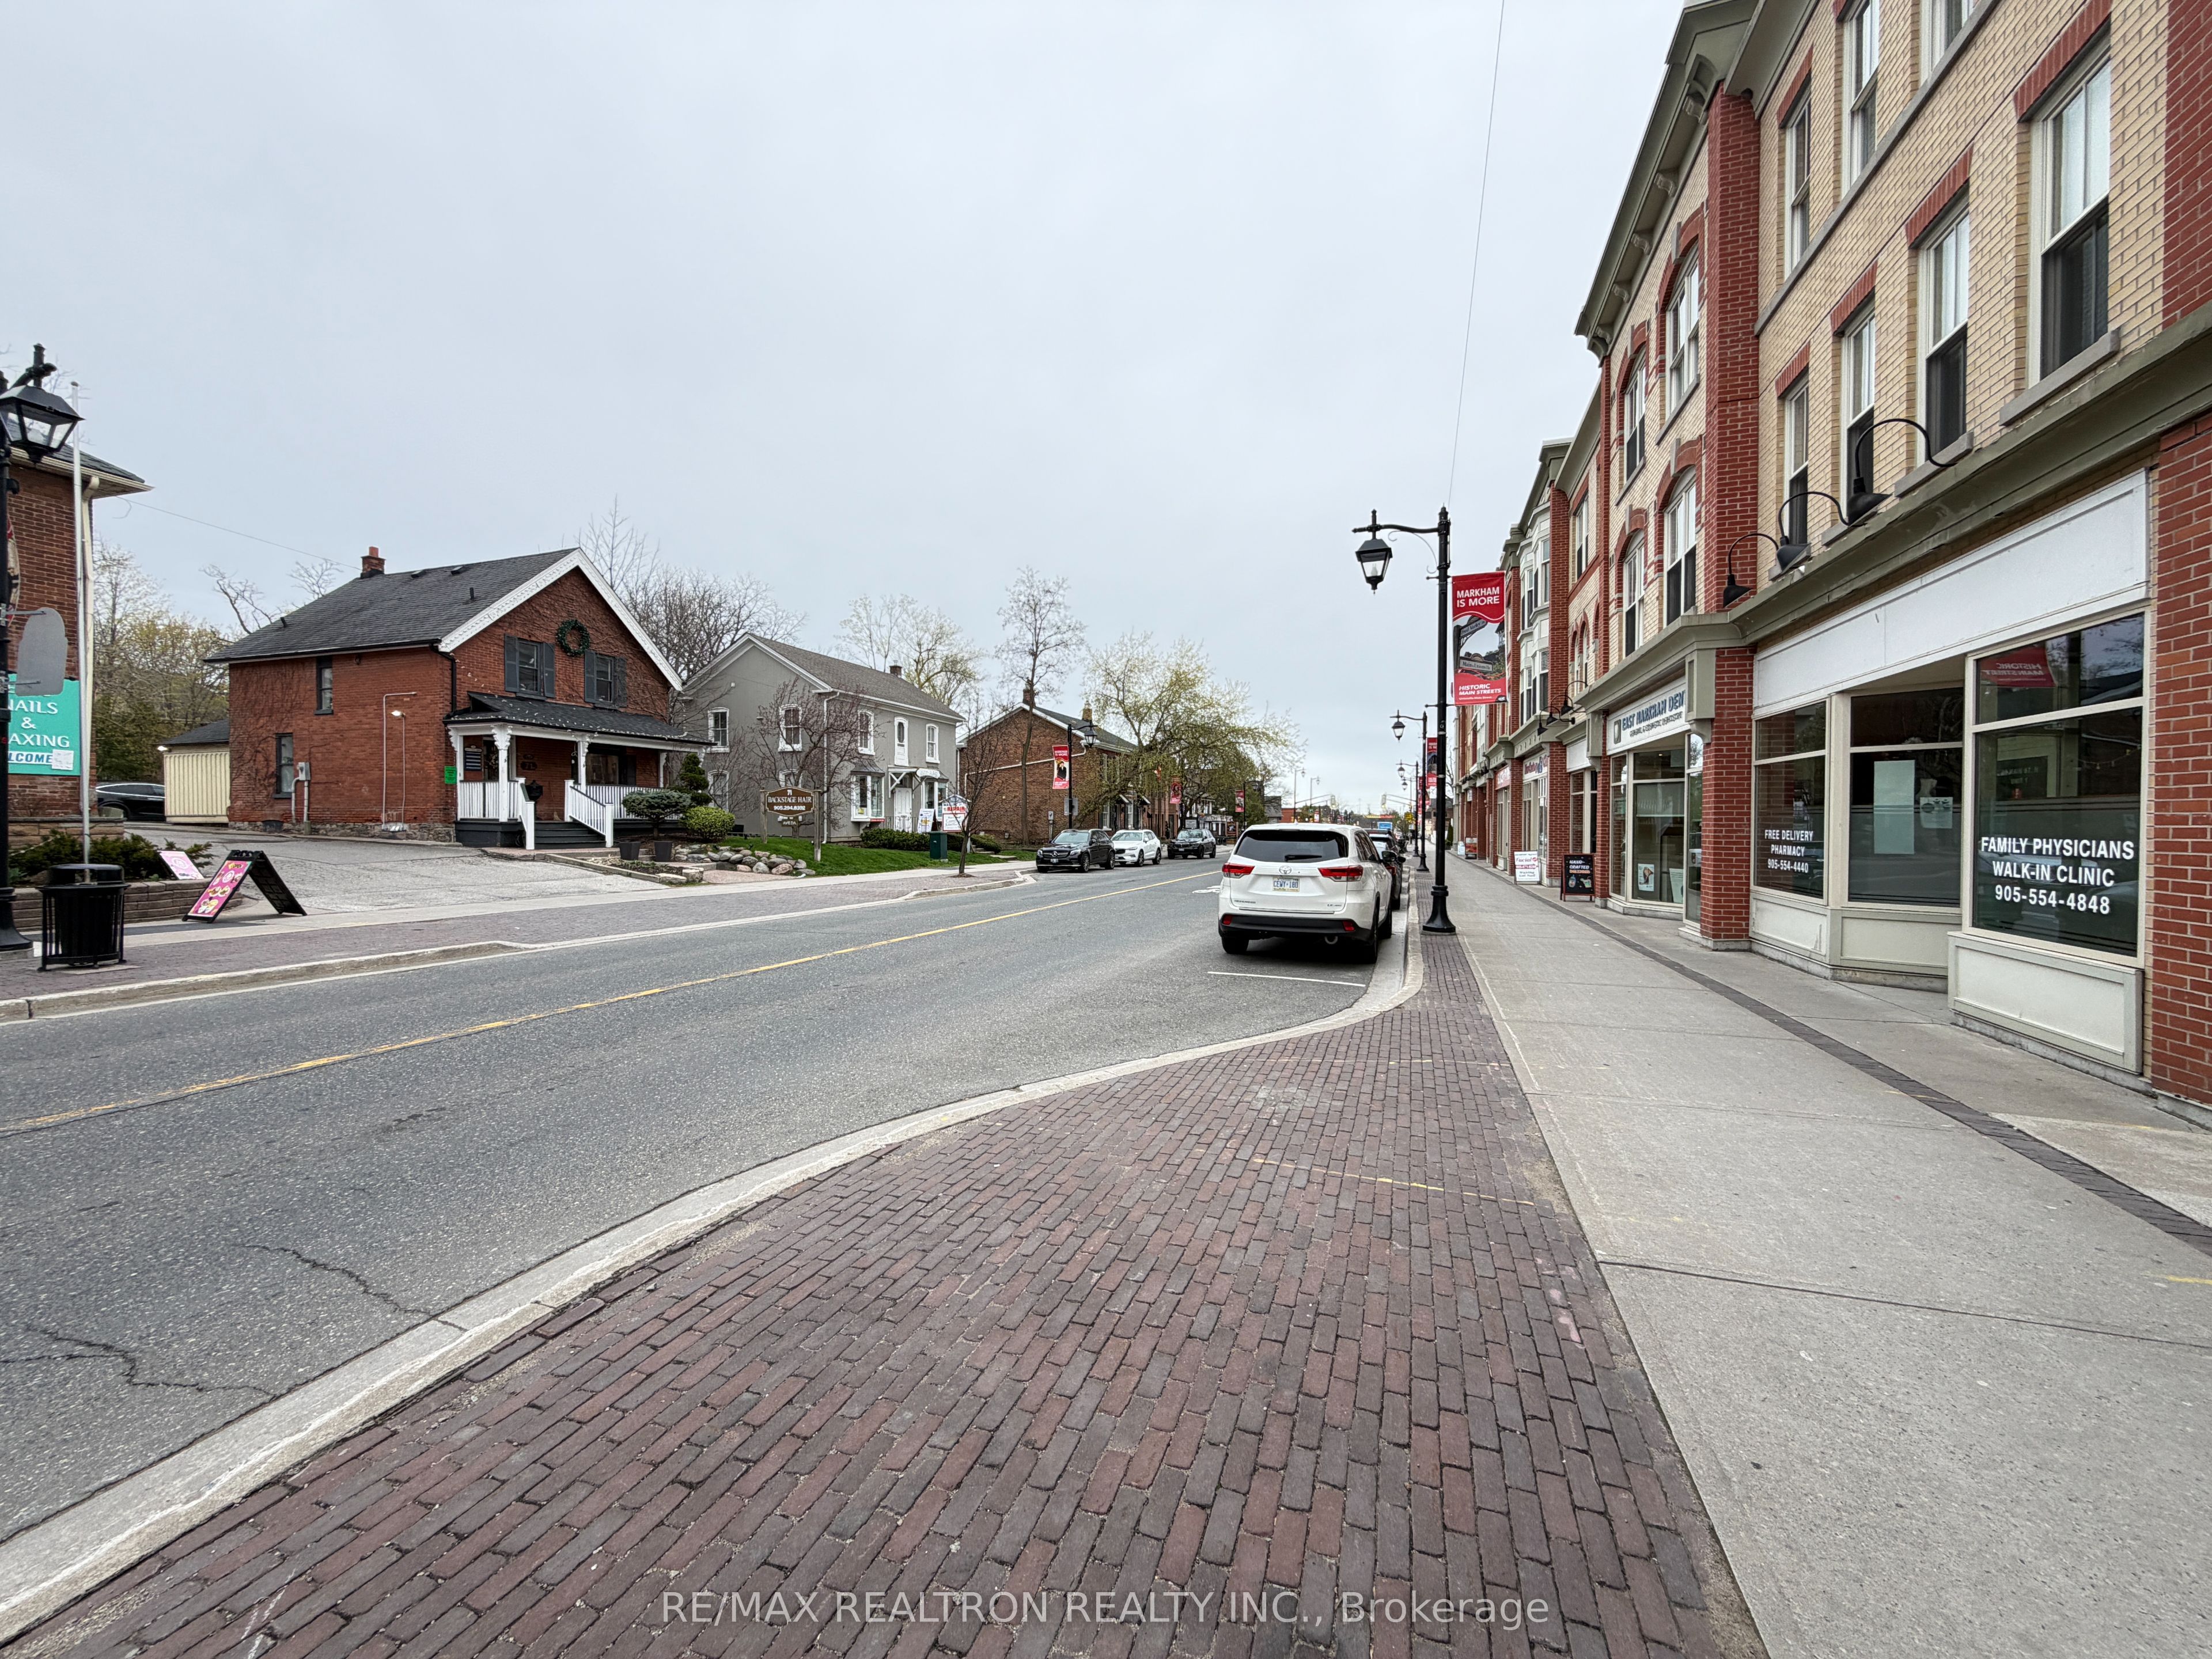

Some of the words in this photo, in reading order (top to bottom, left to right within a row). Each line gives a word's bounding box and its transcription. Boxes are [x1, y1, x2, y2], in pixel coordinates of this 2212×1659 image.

[1457, 586, 1499, 599] MARKHAM
[1457, 599, 1465, 608] IS
[1468, 596, 1500, 607] MORE
[1459, 683, 1491, 691] HISTORIC
[1622, 713, 1635, 731] EAST
[1636, 699, 1666, 725] MARKHAM
[1668, 690, 1685, 712] DEN
[21, 717, 36, 729] &
[9, 733, 70, 748] AXING
[8, 752, 53, 763] LCOME
[1764, 830, 1780, 839] FREE
[1782, 830, 1813, 841] DELIVERY
[1771, 844, 1805, 857] PHARMACY
[1981, 837, 2028, 854] FAMILY
[2033, 838, 2135, 859] PHYSICIANS
[1767, 858, 1808, 873] 905-554-4440
[1992, 861, 2051, 881] WALK-IN
[2056, 865, 2115, 887] CLINIC
[1995, 884, 2111, 915] 905-554-4848
